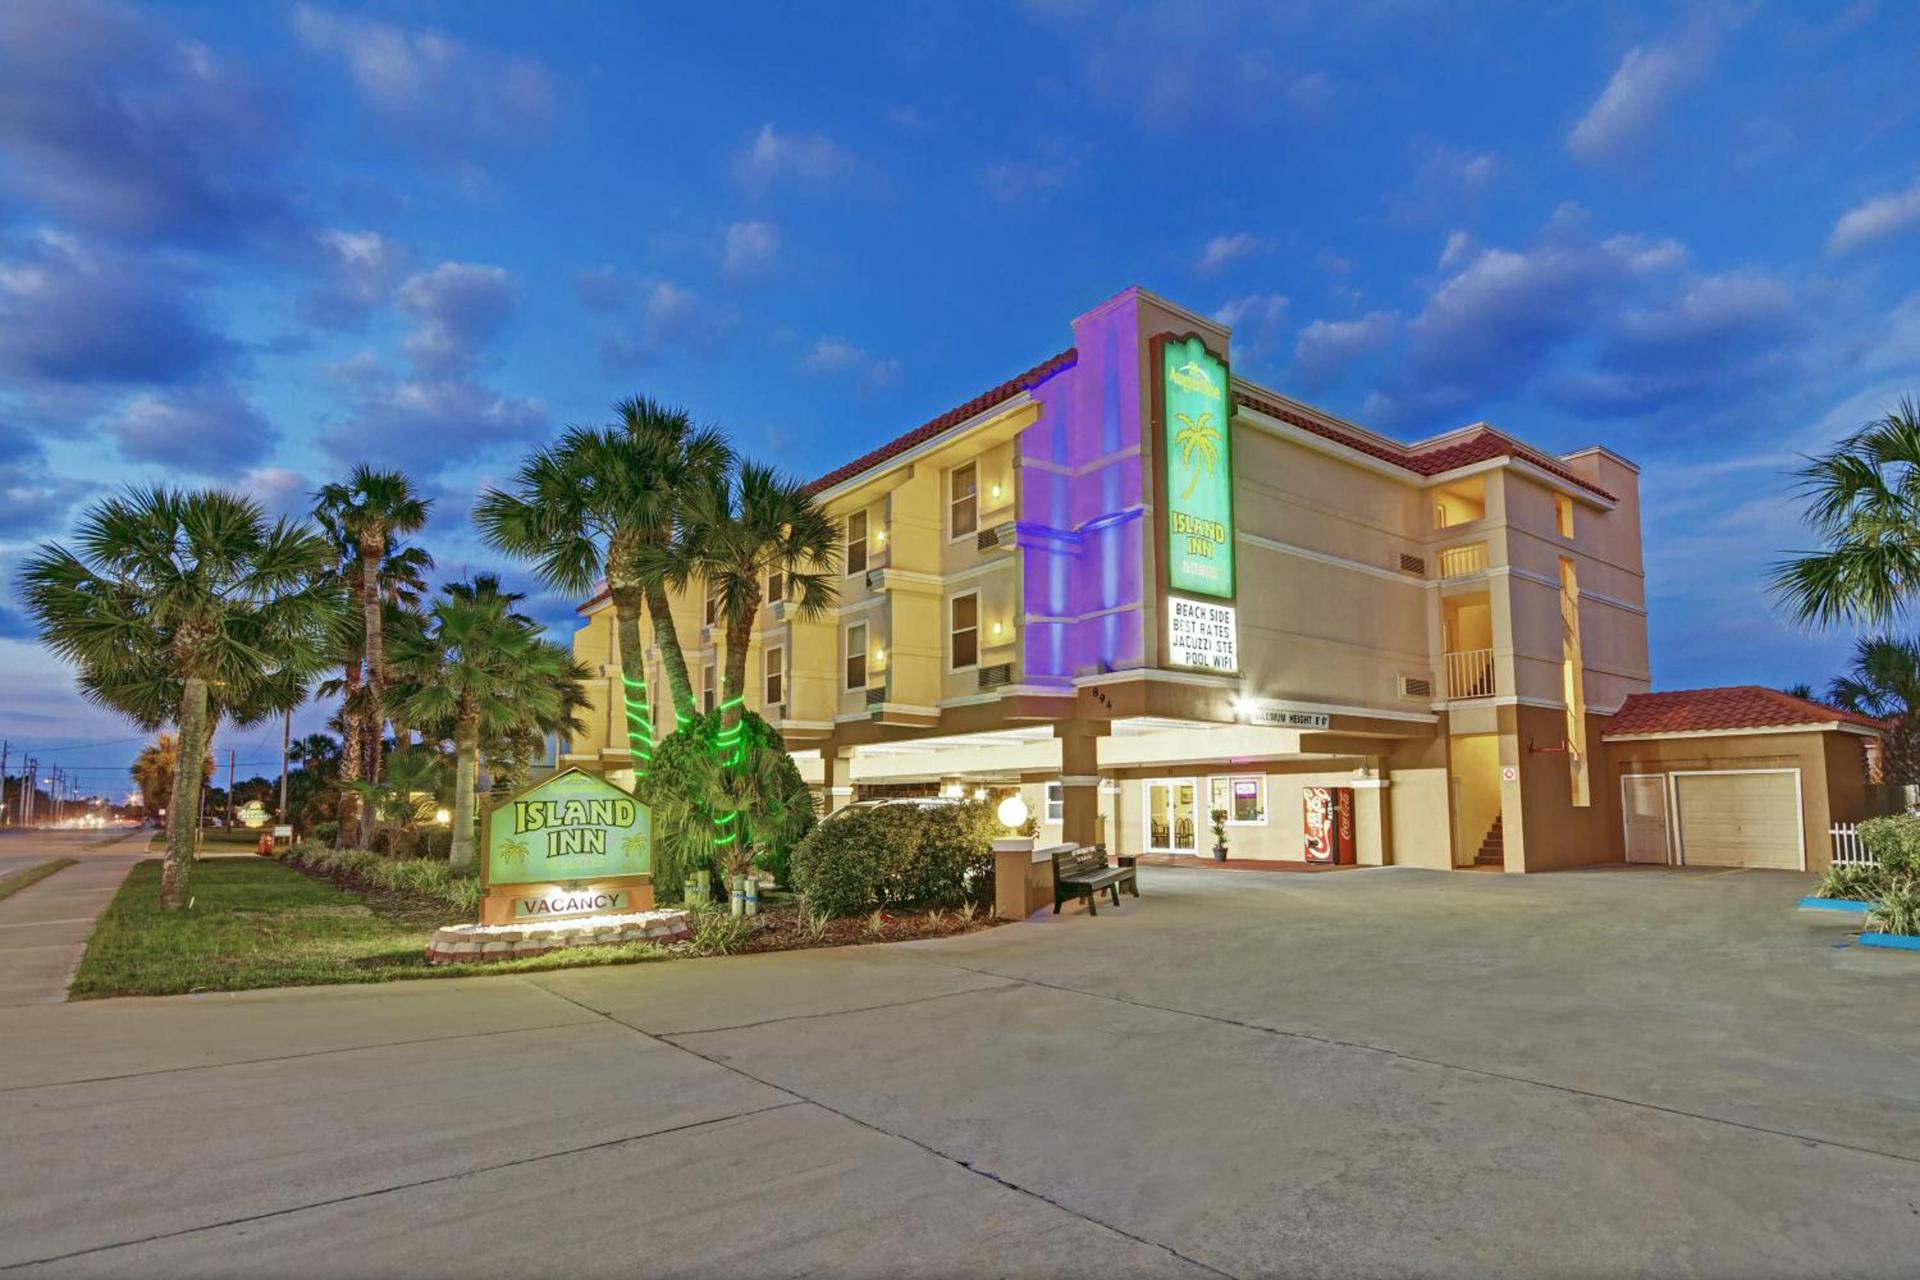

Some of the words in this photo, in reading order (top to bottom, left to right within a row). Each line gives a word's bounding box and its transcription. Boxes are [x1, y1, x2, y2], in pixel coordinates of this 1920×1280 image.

[1172, 510, 1225, 544] ISLAND
[1186, 535, 1213, 560] INN
[1176, 603, 1206, 619] BEACH
[1209, 609, 1229, 624] SIDE
[1173, 618, 1195, 633] BEST
[1200, 623, 1229, 638] RATES
[1172, 634, 1211, 651] JACUZZI
[1216, 640, 1233, 654] STE
[1186, 652, 1209, 667] POOL
[1213, 655, 1232, 669] WIFI
[1092, 687, 1112, 711] 894
[1289, 714, 1312, 725] HEIGHT
[514, 798, 636, 835] ISLAND
[546, 828, 607, 858] INN
[524, 893, 620, 914] VACANCY
